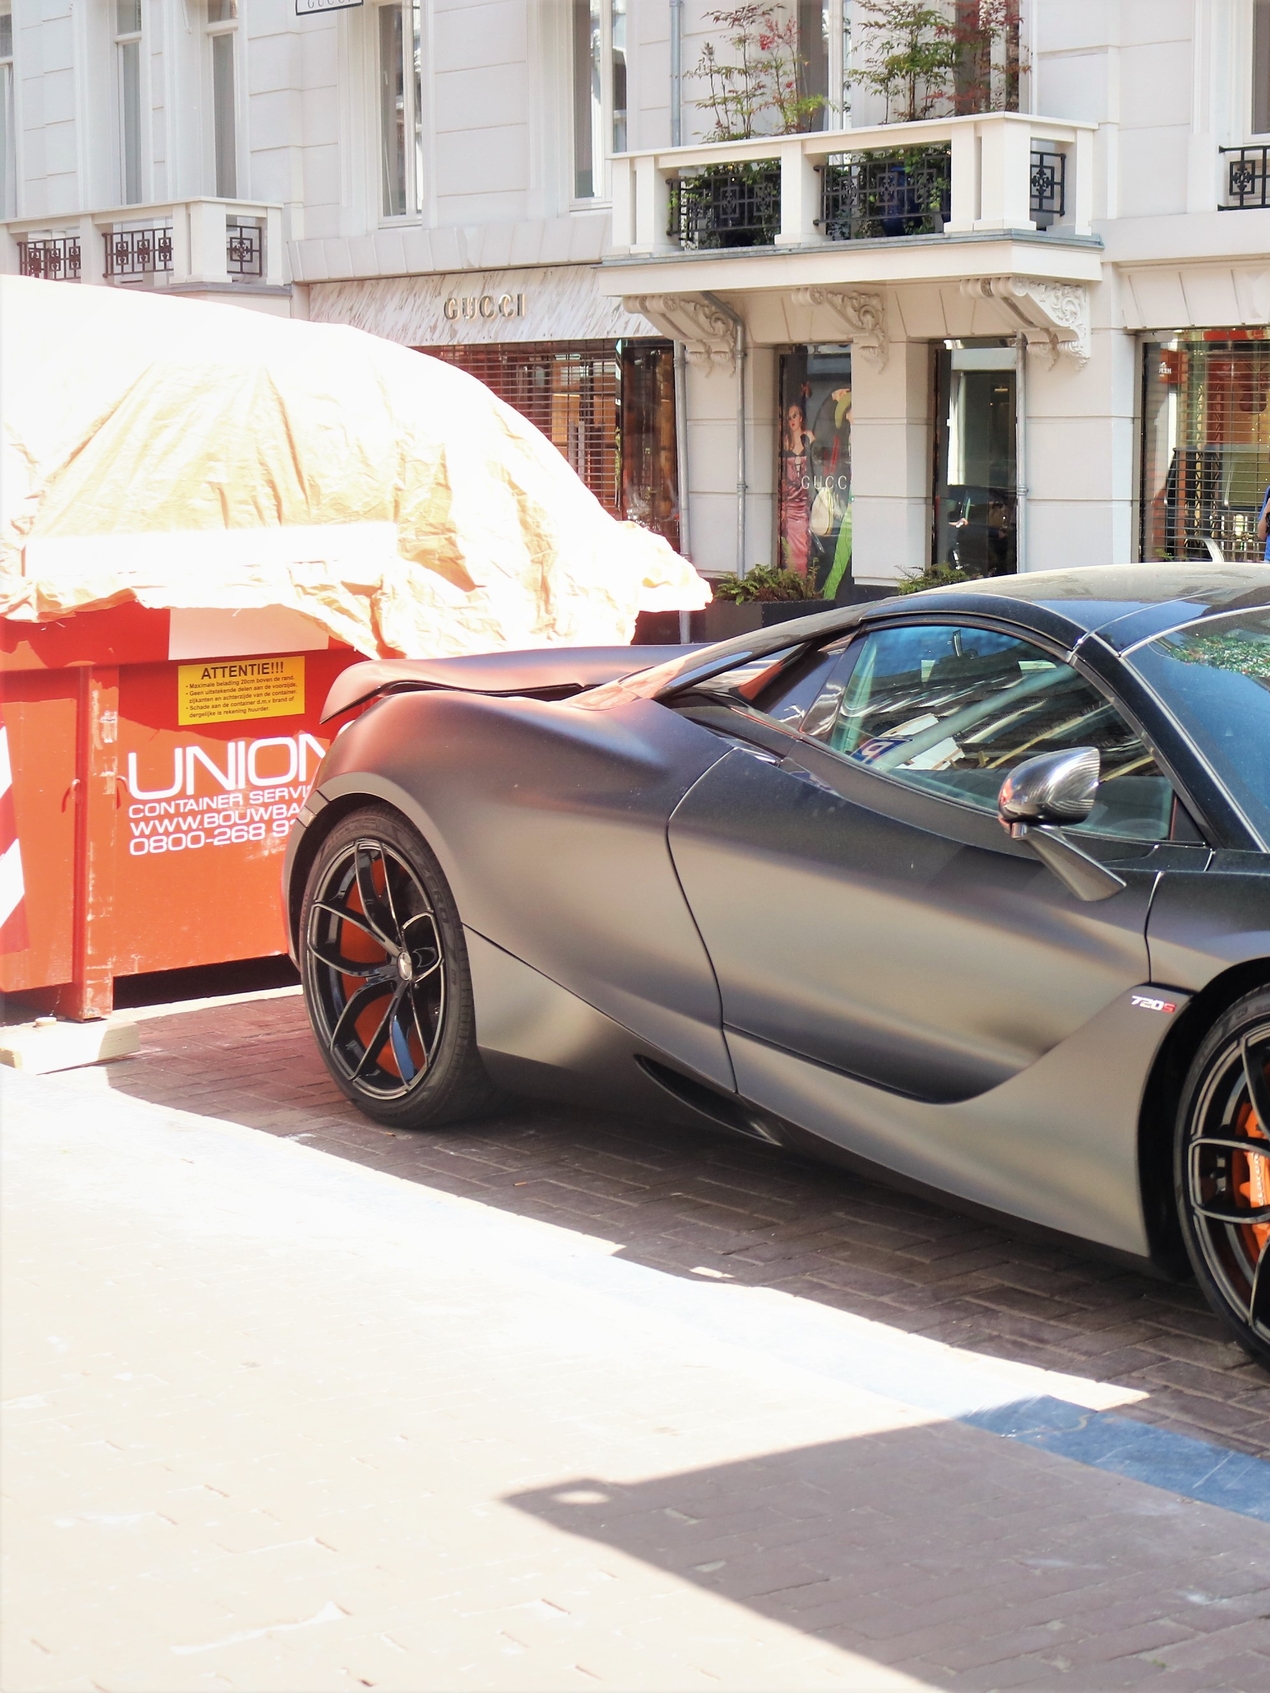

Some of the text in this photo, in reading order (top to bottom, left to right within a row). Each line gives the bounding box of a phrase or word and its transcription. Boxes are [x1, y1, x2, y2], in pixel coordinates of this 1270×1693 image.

[443, 293, 525, 321] GUCCI
[801, 475, 848, 490] GUCC
[201, 661, 284, 680] ATTENTIE!!!
[223, 693, 252, 701] achterzijde
[189, 710, 216, 718] dergelijke
[128, 784, 311, 818] CONTAINER SERVI
[129, 800, 300, 837] WWW.BOUWBA
[128, 823, 266, 856] 0800-268
[271, 819, 297, 838] 9
[1131, 995, 1177, 1014] 720S
[1251, 1151, 1265, 1206] cLaren
